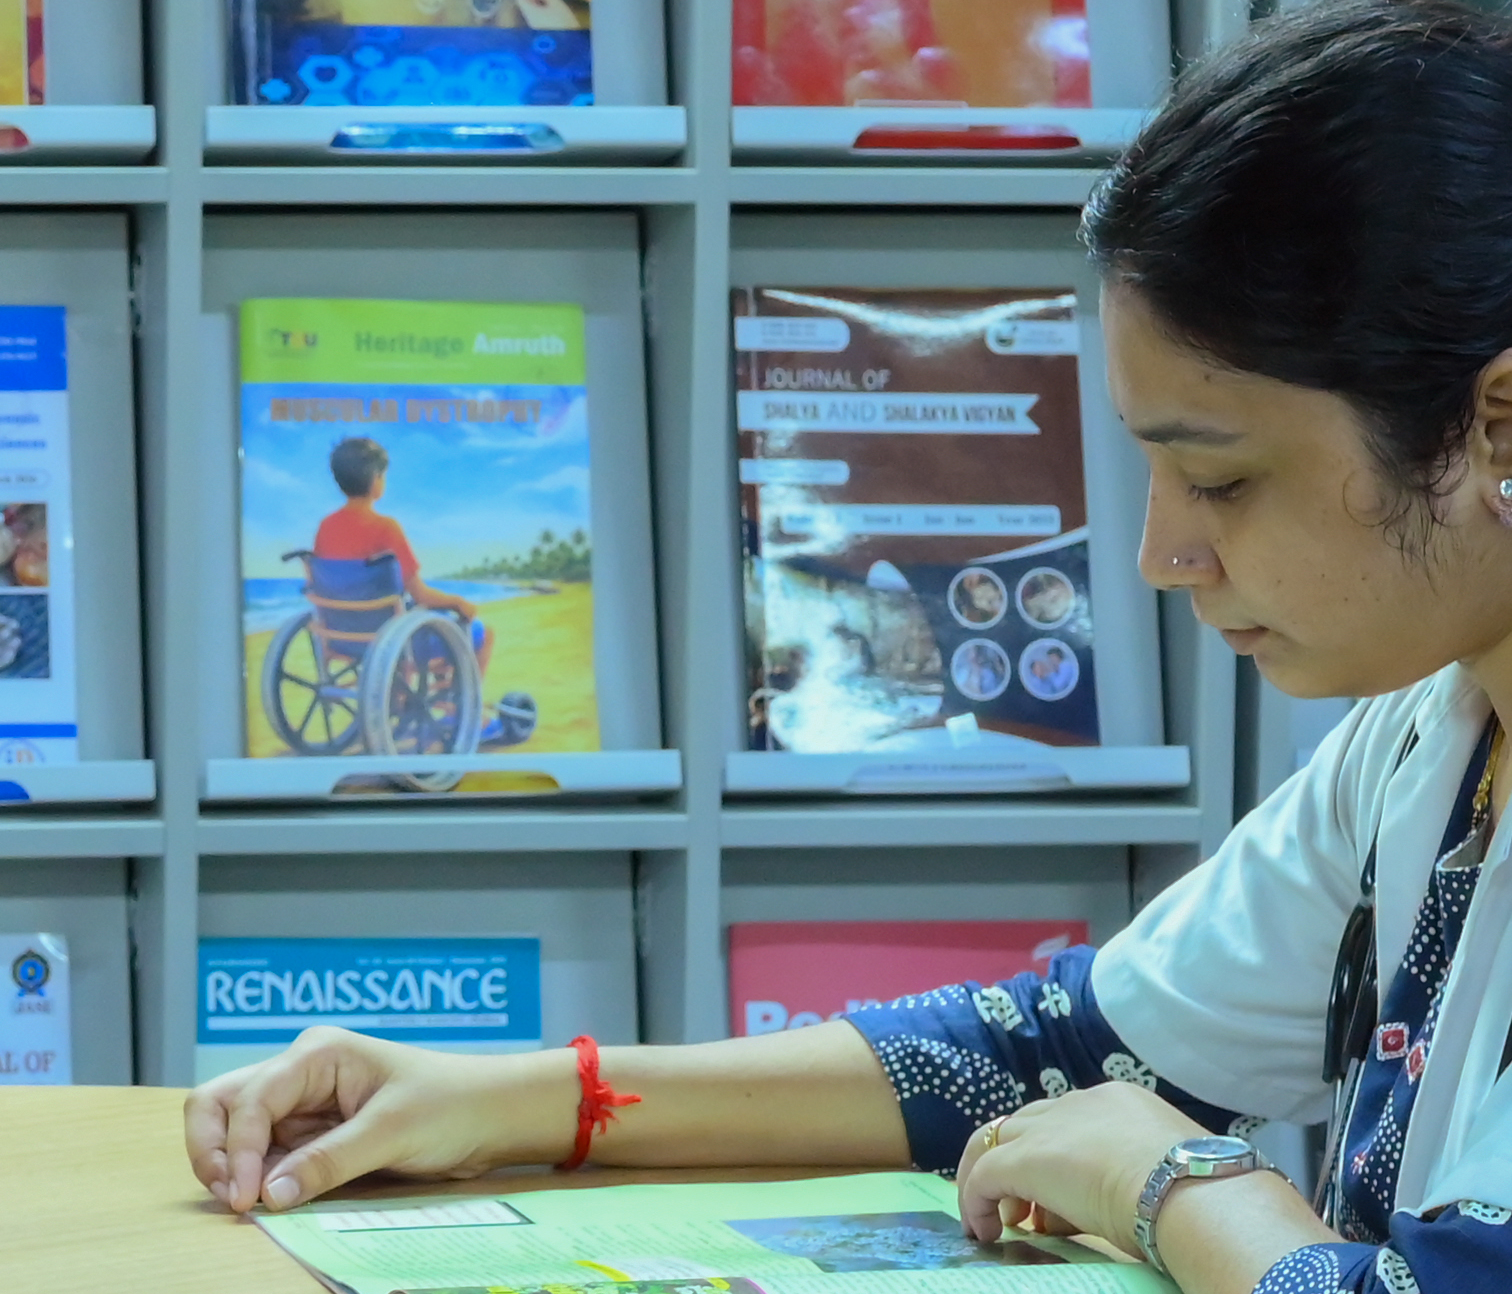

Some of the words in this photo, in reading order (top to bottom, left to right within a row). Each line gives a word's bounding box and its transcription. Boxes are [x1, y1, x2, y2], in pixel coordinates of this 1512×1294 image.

[354, 332, 465, 359] Heritage
[765, 367, 856, 390] JOURNAL
[862, 368, 892, 390] OF
[827, 401, 876, 423] AND
[206, 968, 508, 1012] RENAISSANCE
[25, 1050, 56, 1073] OF
